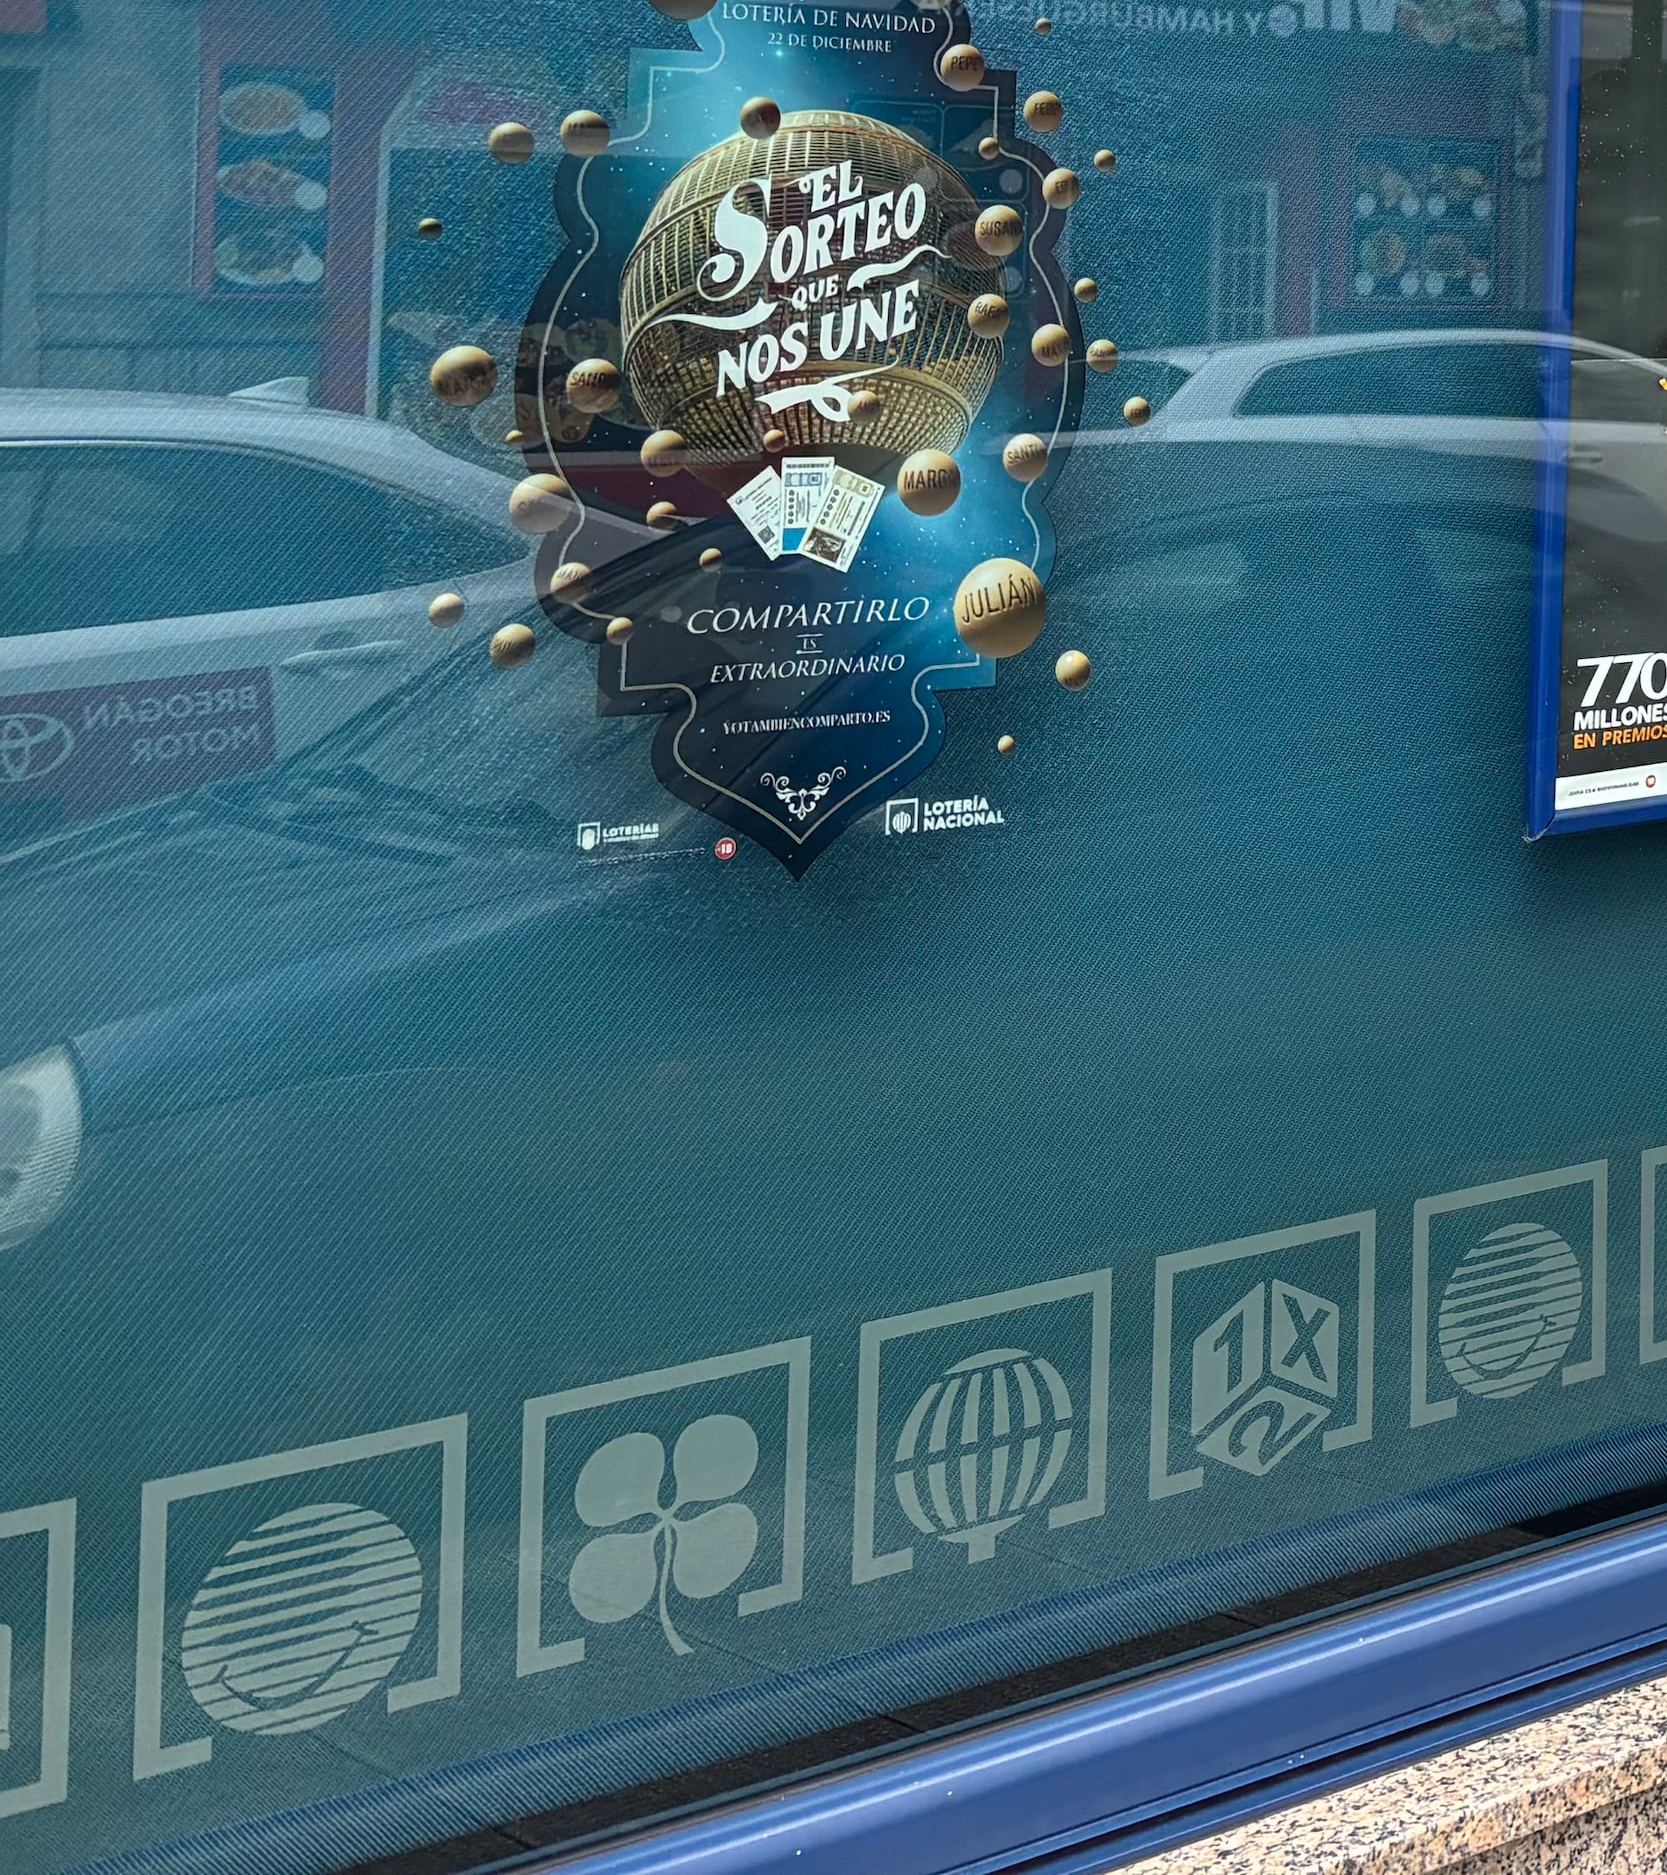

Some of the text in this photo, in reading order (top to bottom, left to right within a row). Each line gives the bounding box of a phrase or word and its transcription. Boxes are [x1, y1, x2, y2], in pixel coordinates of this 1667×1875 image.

[723, 2, 936, 34] LOTERÍA DE NAVIDAD
[767, 32, 892, 53] 22 DE DICIEMBRE
[799, 159, 864, 213] EL
[697, 171, 927, 302] SORTEO
[791, 275, 839, 311] QUE
[716, 279, 919, 398] NOS UNE
[687, 596, 930, 634] COMPARTIRLO
[962, 574, 1036, 624] JULIÁN
[803, 638, 817, 650] ES
[710, 653, 905, 684] EXTRAORDINARIO
[1572, 733, 1596, 750] EN
[924, 795, 990, 816] LOTERÍA
[924, 810, 1005, 832] NACIONAL
